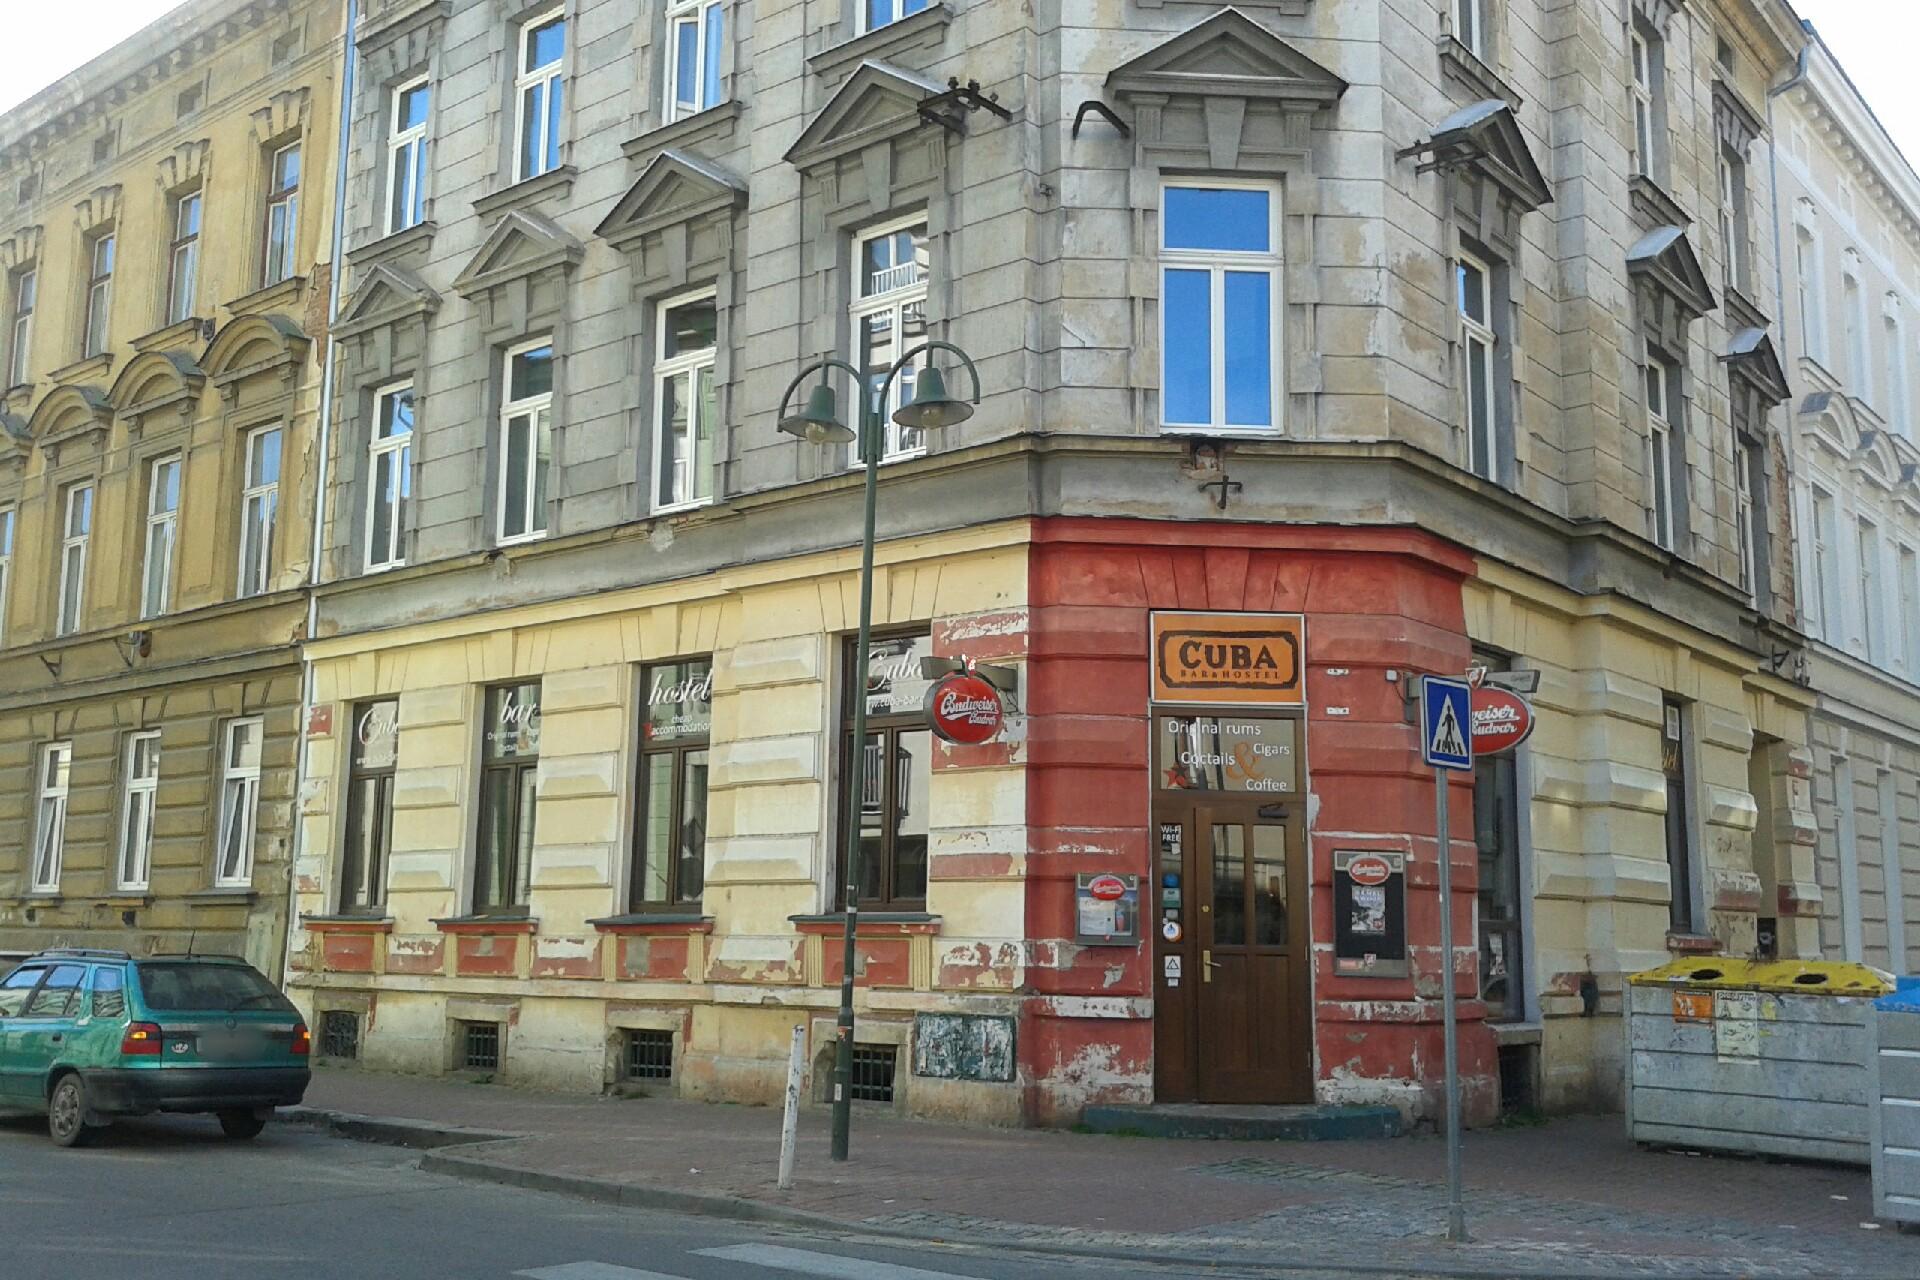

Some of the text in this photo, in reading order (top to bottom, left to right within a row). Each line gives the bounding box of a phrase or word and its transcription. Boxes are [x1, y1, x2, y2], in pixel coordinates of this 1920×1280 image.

[1179, 640, 1278, 669] CUBA
[647, 668, 713, 706] hostel
[500, 692, 537, 723] bar
[941, 692, 999, 718] Budweiser
[1168, 720, 1261, 736] Orinal rums
[1181, 751, 1236, 765] Coctails
[1253, 743, 1290, 757] Cigars
[1245, 778, 1287, 791] Coffee
[1162, 834, 1180, 842] FREE
